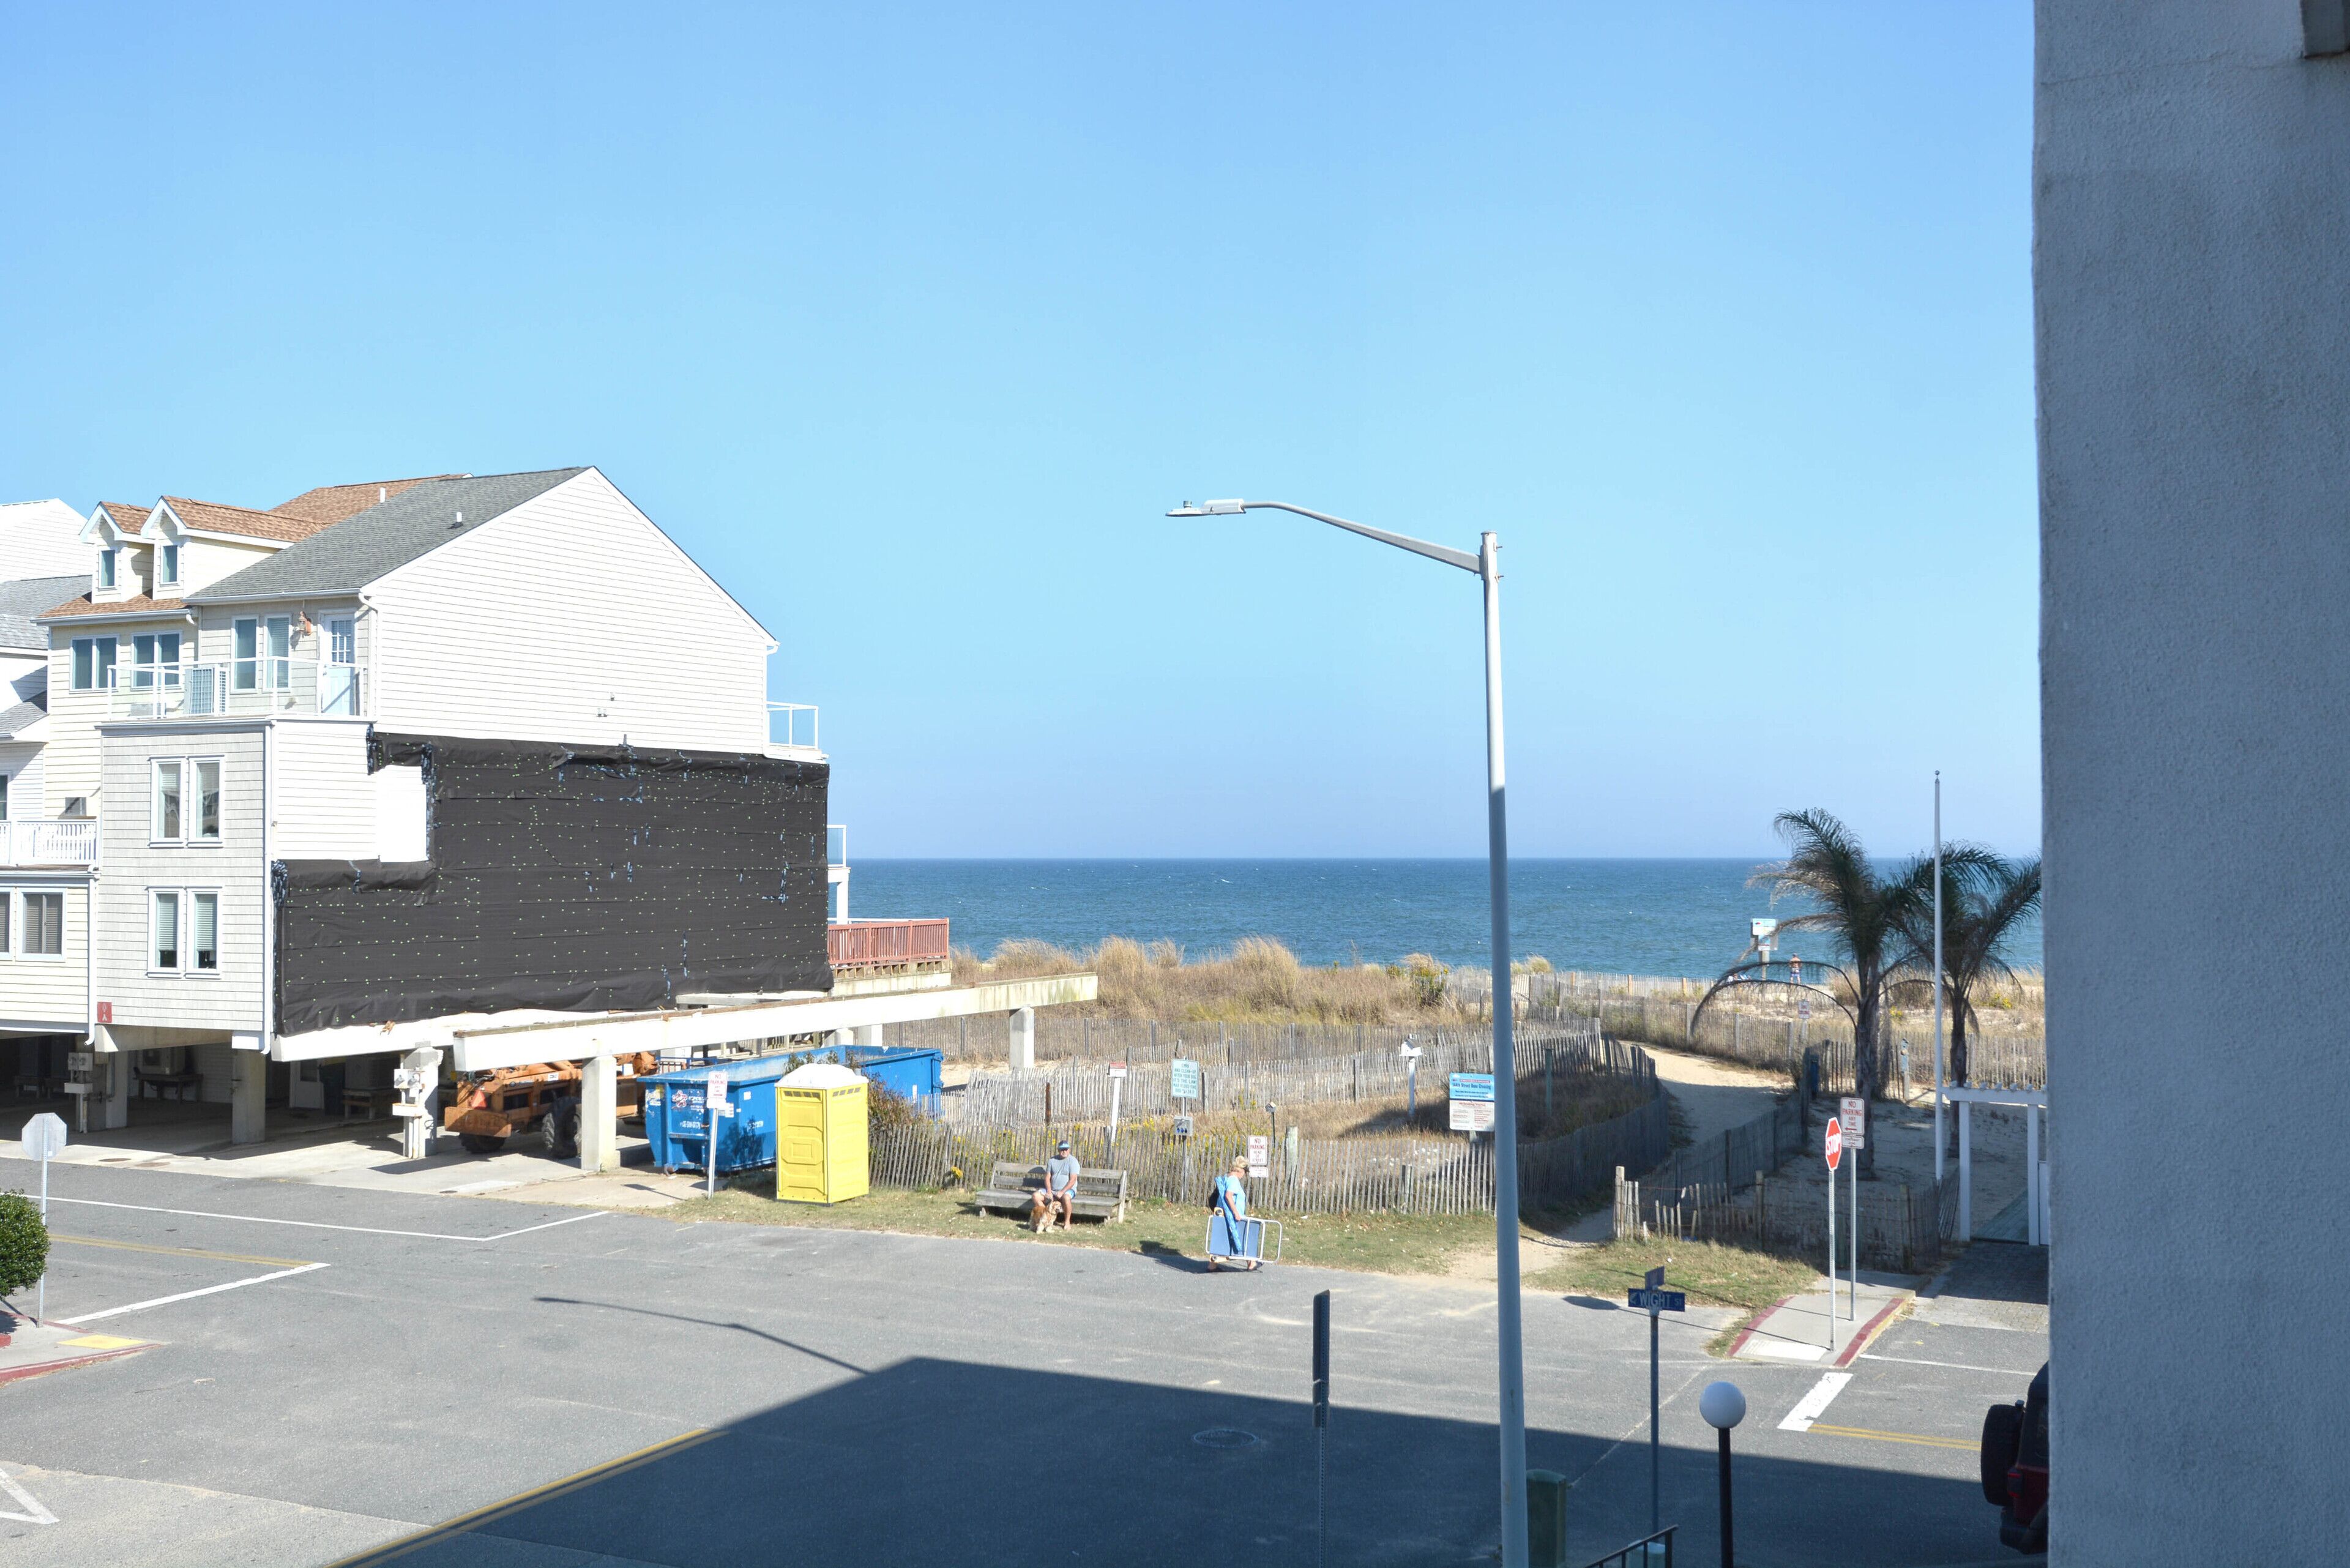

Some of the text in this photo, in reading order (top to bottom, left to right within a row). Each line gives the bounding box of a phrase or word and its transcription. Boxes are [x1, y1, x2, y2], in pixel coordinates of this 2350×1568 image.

[1842, 1108, 1863, 1117] PARKING
[1826, 1133, 1841, 1155] STOP
[1639, 1291, 1671, 1308] WIGHT
